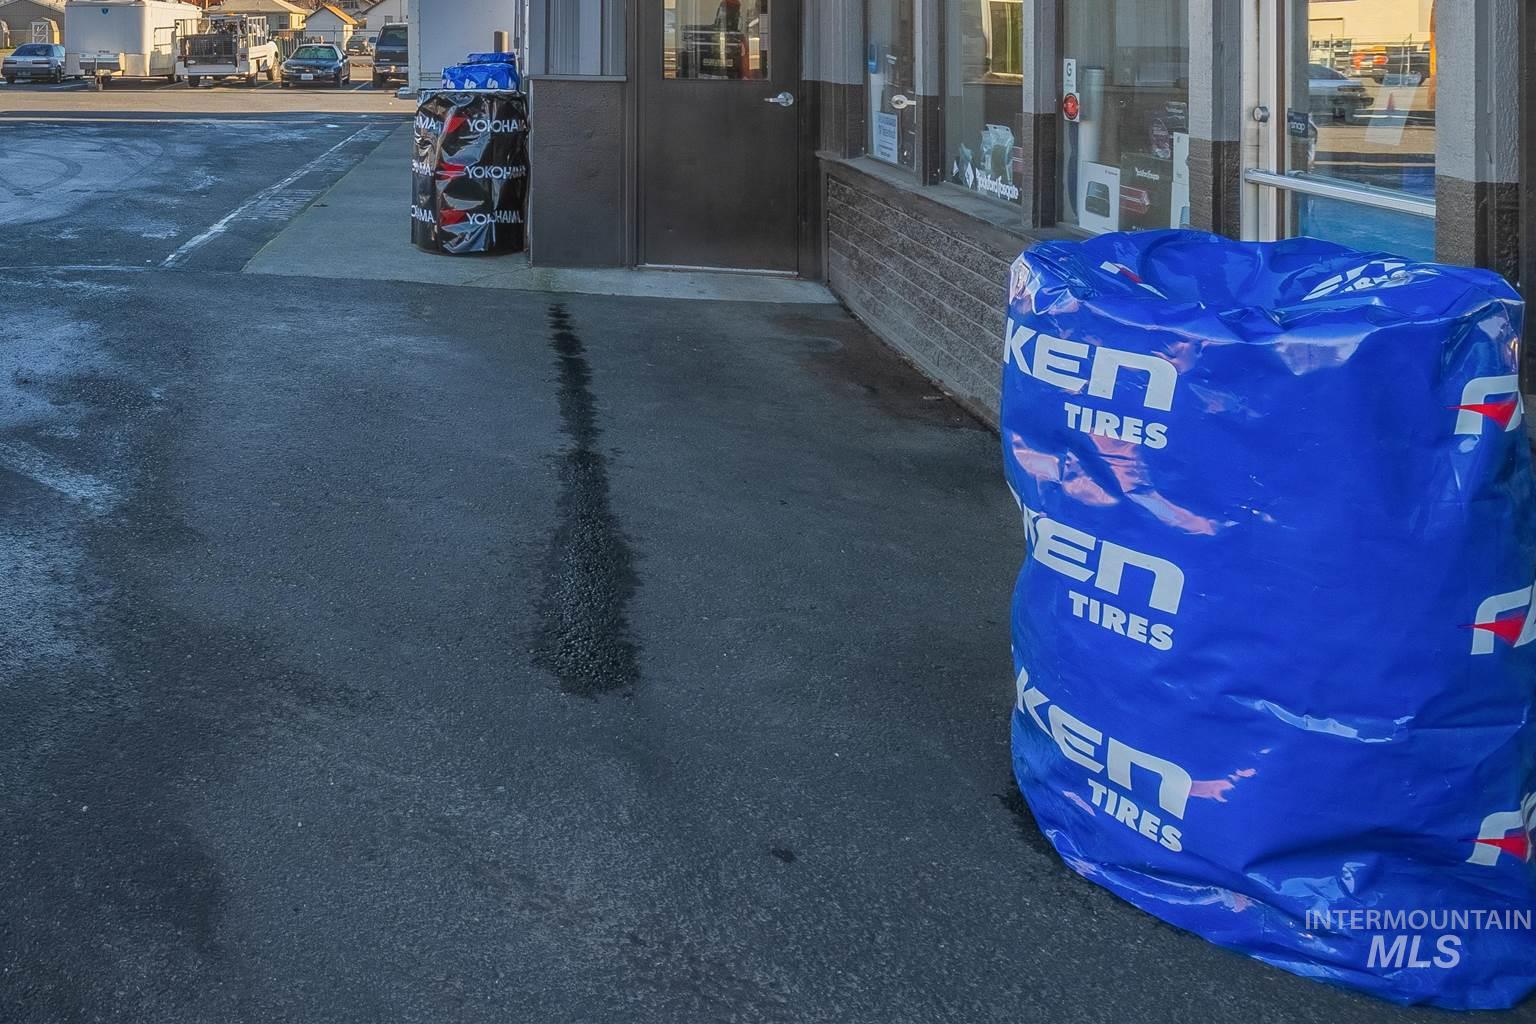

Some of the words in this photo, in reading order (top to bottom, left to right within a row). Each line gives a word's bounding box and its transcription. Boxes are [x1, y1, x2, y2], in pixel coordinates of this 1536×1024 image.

[1064, 402, 1169, 449] TIRES
[1068, 590, 1174, 651] TIRES
[1088, 778, 1183, 852] TIRES
